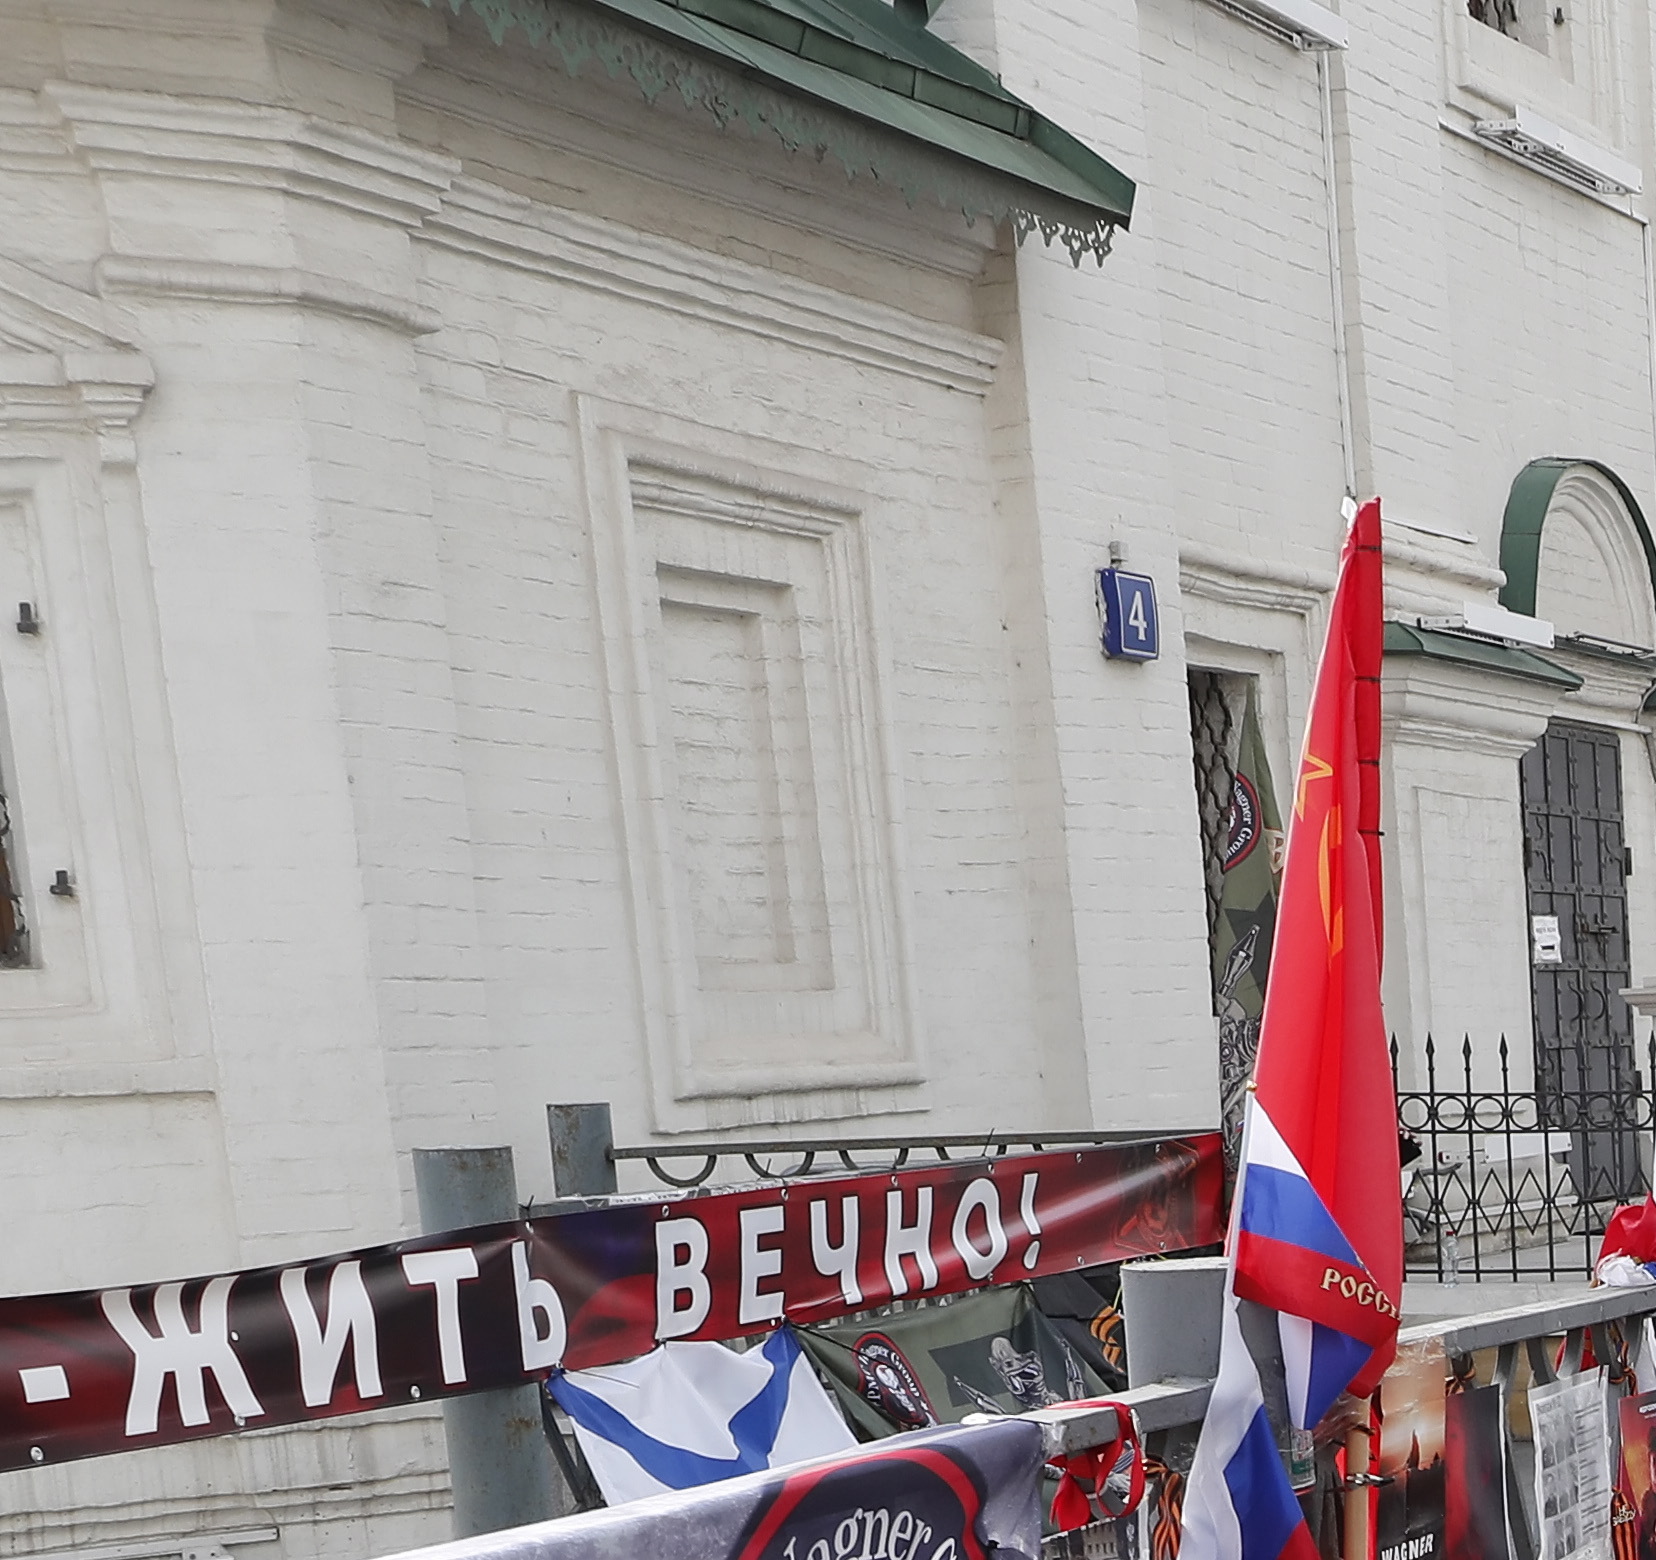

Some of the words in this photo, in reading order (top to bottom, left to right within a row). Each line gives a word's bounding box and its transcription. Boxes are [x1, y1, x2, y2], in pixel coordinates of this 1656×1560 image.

[1128, 590, 1147, 641] 4
[99, 1240, 567, 1438] ЖИТЬ
[655, 1171, 1042, 1340] ВЕЧНО!
